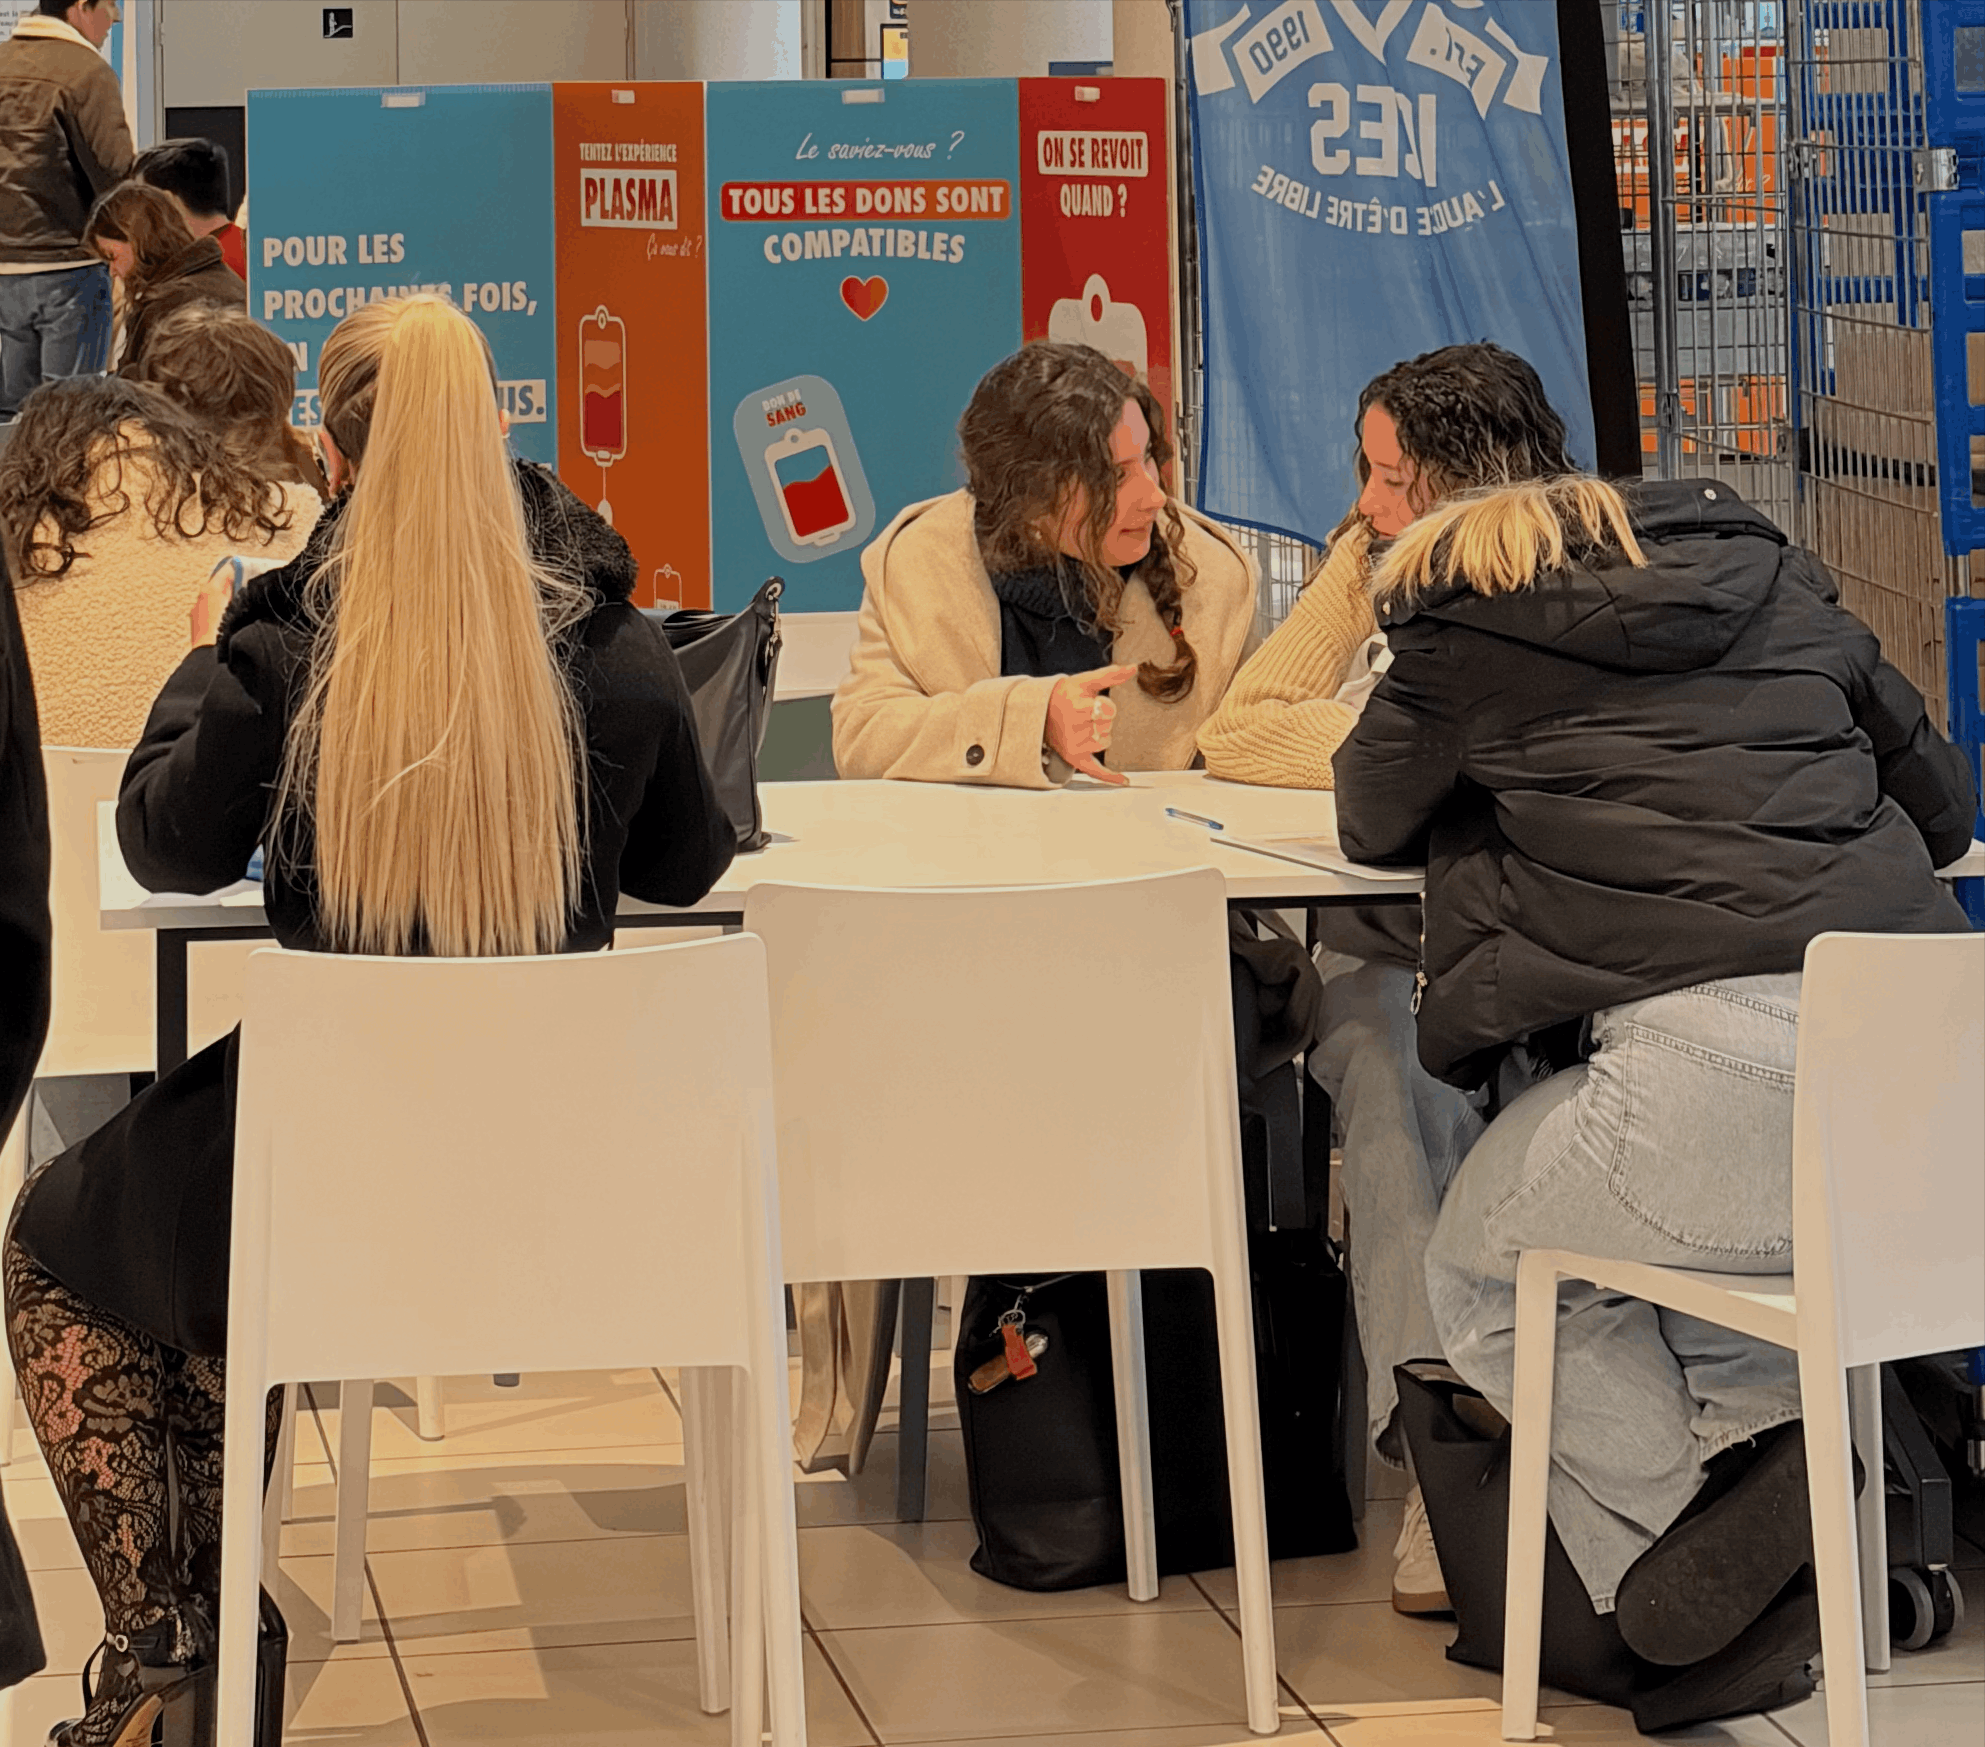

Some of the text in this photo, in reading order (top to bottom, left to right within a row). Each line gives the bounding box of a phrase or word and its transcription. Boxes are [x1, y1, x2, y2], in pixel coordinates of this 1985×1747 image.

[580, 138, 677, 162] TENTEZ L'EXPÉRIENCE
[795, 130, 965, 160] Le saviez-vous ?
[1043, 137, 1143, 170] ON SE REVOIT
[585, 177, 674, 222] PLASMA
[728, 186, 1004, 214] TOUS LES DONS SONT
[1060, 183, 1127, 218] QUAND ?
[263, 233, 405, 267] POUR LES
[763, 228, 965, 264] COMPATIBLES
[463, 281, 538, 316] FOIS,
[766, 402, 806, 427] SANG
